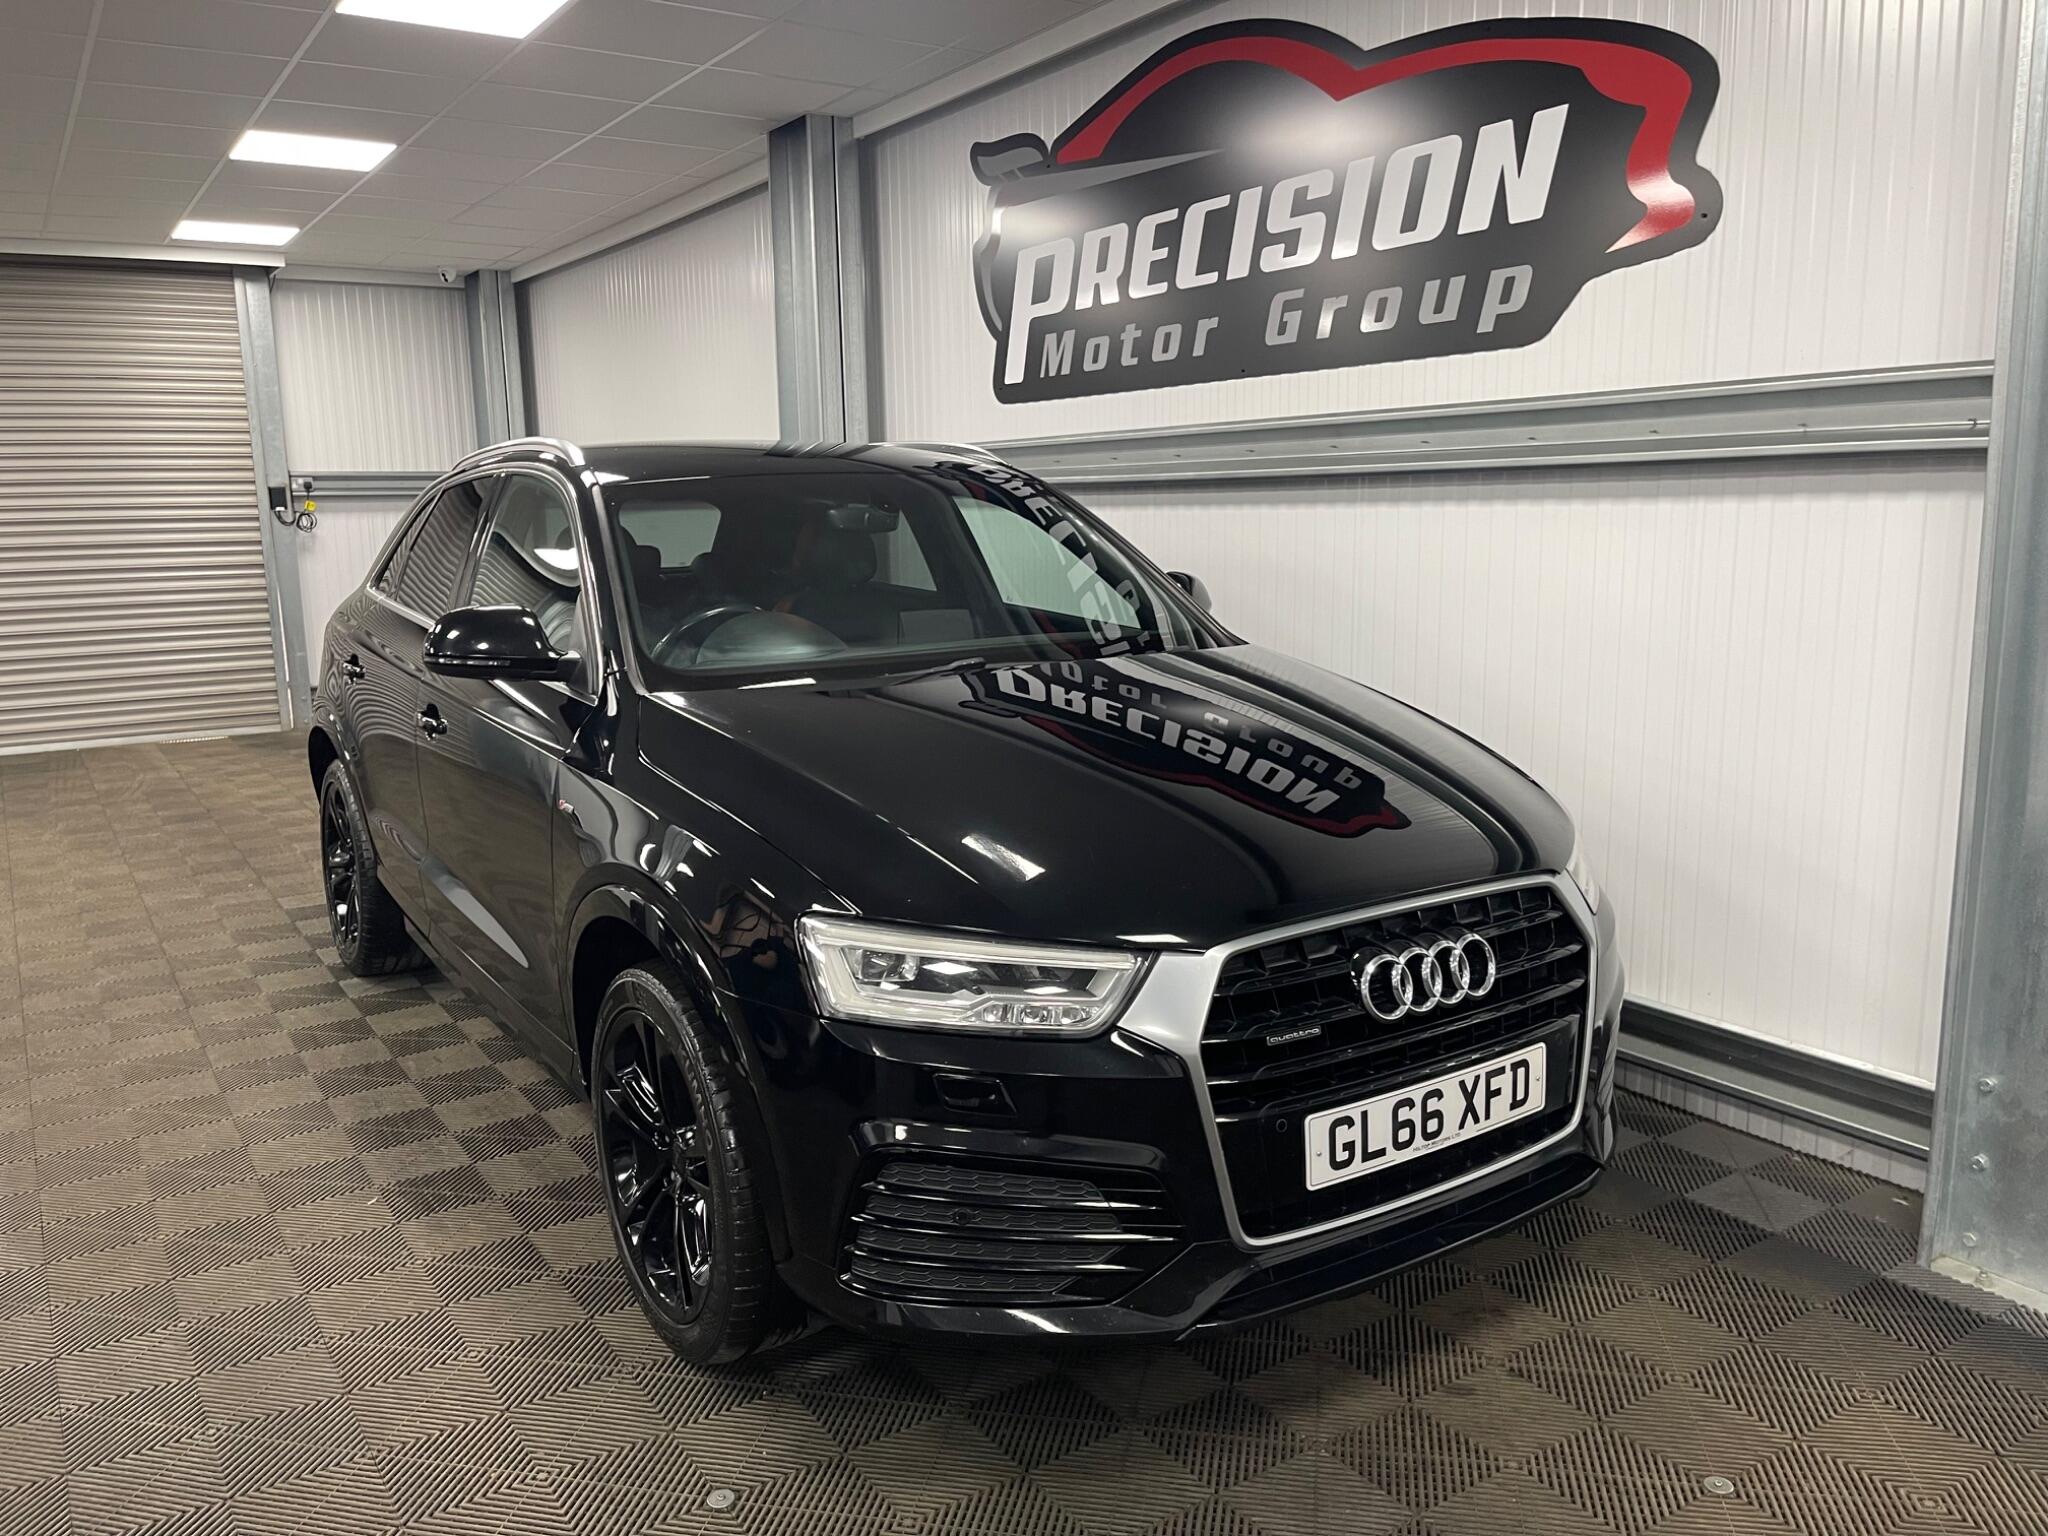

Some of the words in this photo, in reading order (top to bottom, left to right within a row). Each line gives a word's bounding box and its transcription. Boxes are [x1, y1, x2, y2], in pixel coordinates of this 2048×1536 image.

[1005, 103, 1570, 386] PRECISION
[1040, 312, 1218, 378] Motor
[1264, 264, 1534, 347] Group
[1269, 1027, 1320, 1043] quattro
[1328, 1087, 1445, 1172] GL66
[1458, 1058, 1530, 1131] XFD
